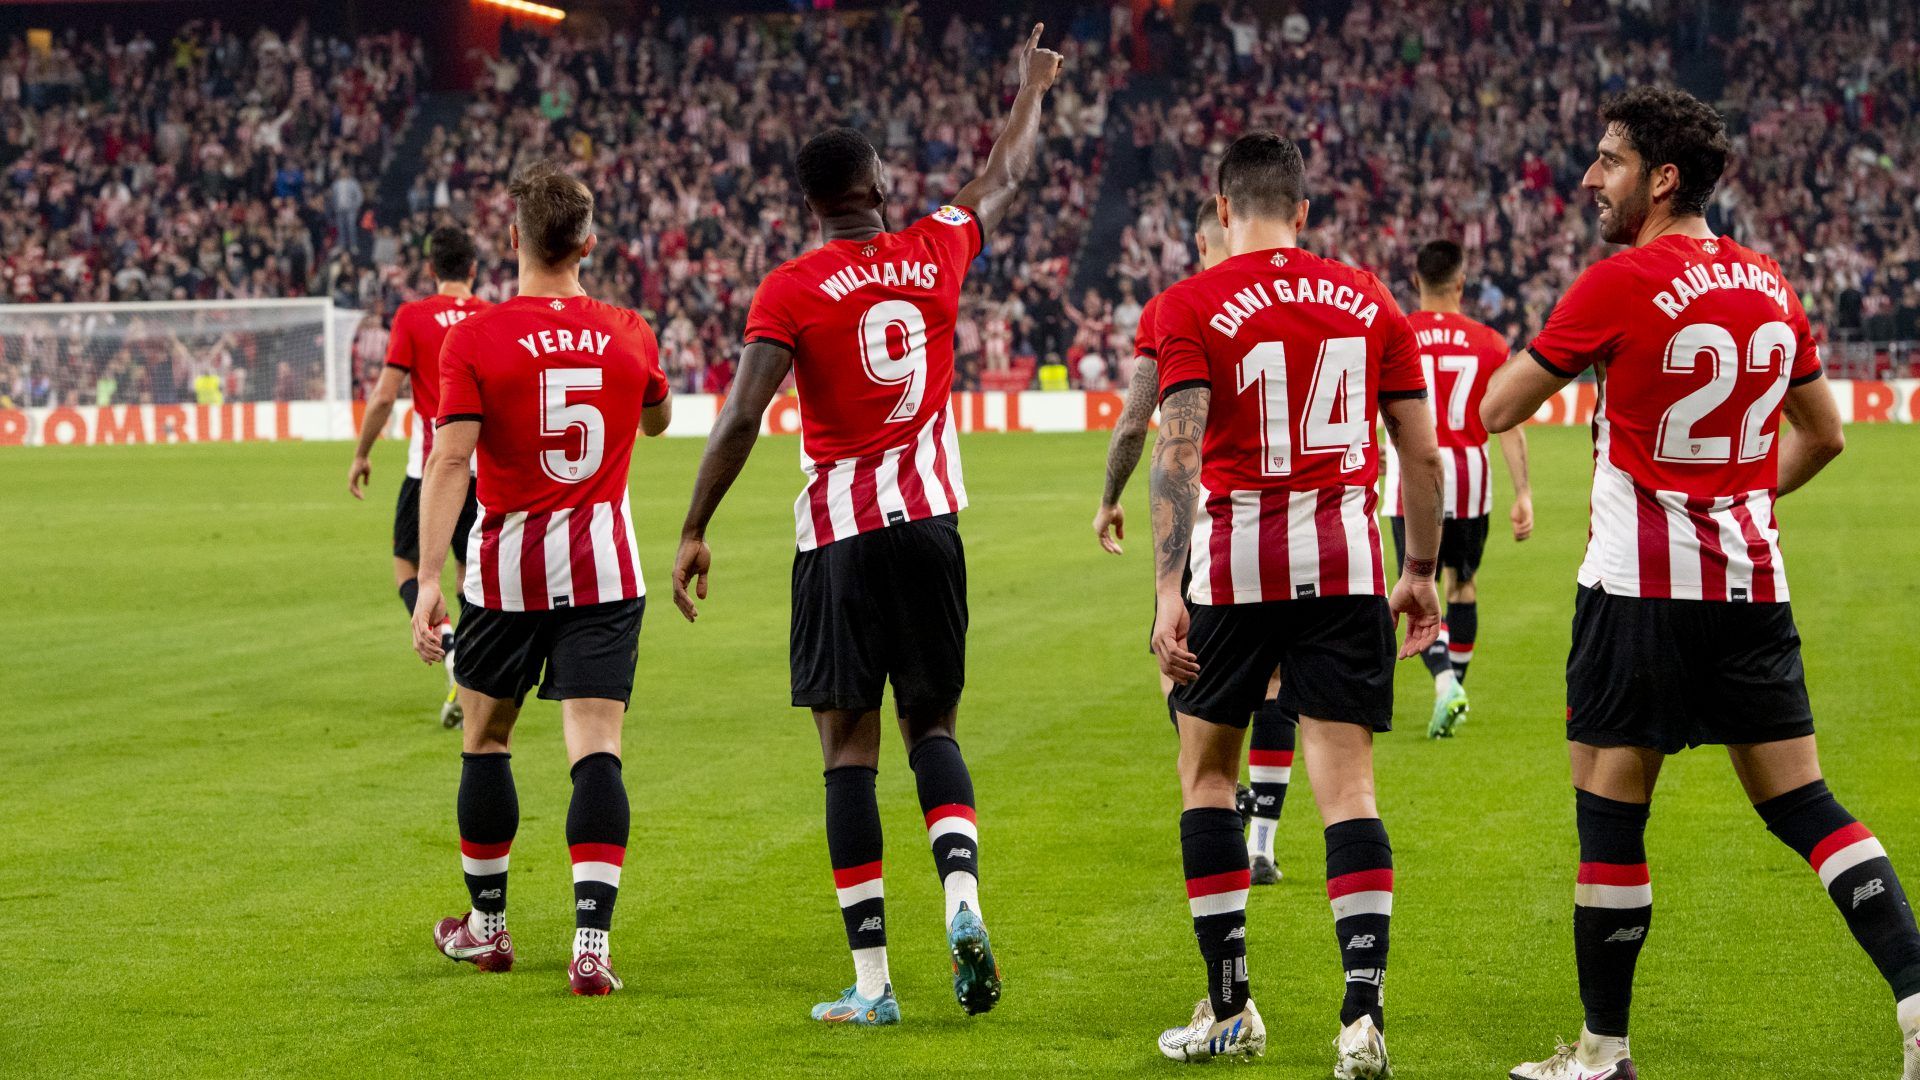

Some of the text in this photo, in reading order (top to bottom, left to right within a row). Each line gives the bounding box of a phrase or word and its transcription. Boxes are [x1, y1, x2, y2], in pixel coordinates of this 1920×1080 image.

[819, 261, 938, 302] WILLIAMS
[1209, 277, 1380, 339] DANI GARCIA
[517, 329, 612, 358] YERAY
[857, 299, 928, 424] 9
[1416, 328, 1451, 349] URI
[539, 367, 605, 485] 5
[1235, 336, 1371, 477] 14
[1420, 354, 1479, 432] 17
[1653, 320, 1797, 465] 22
